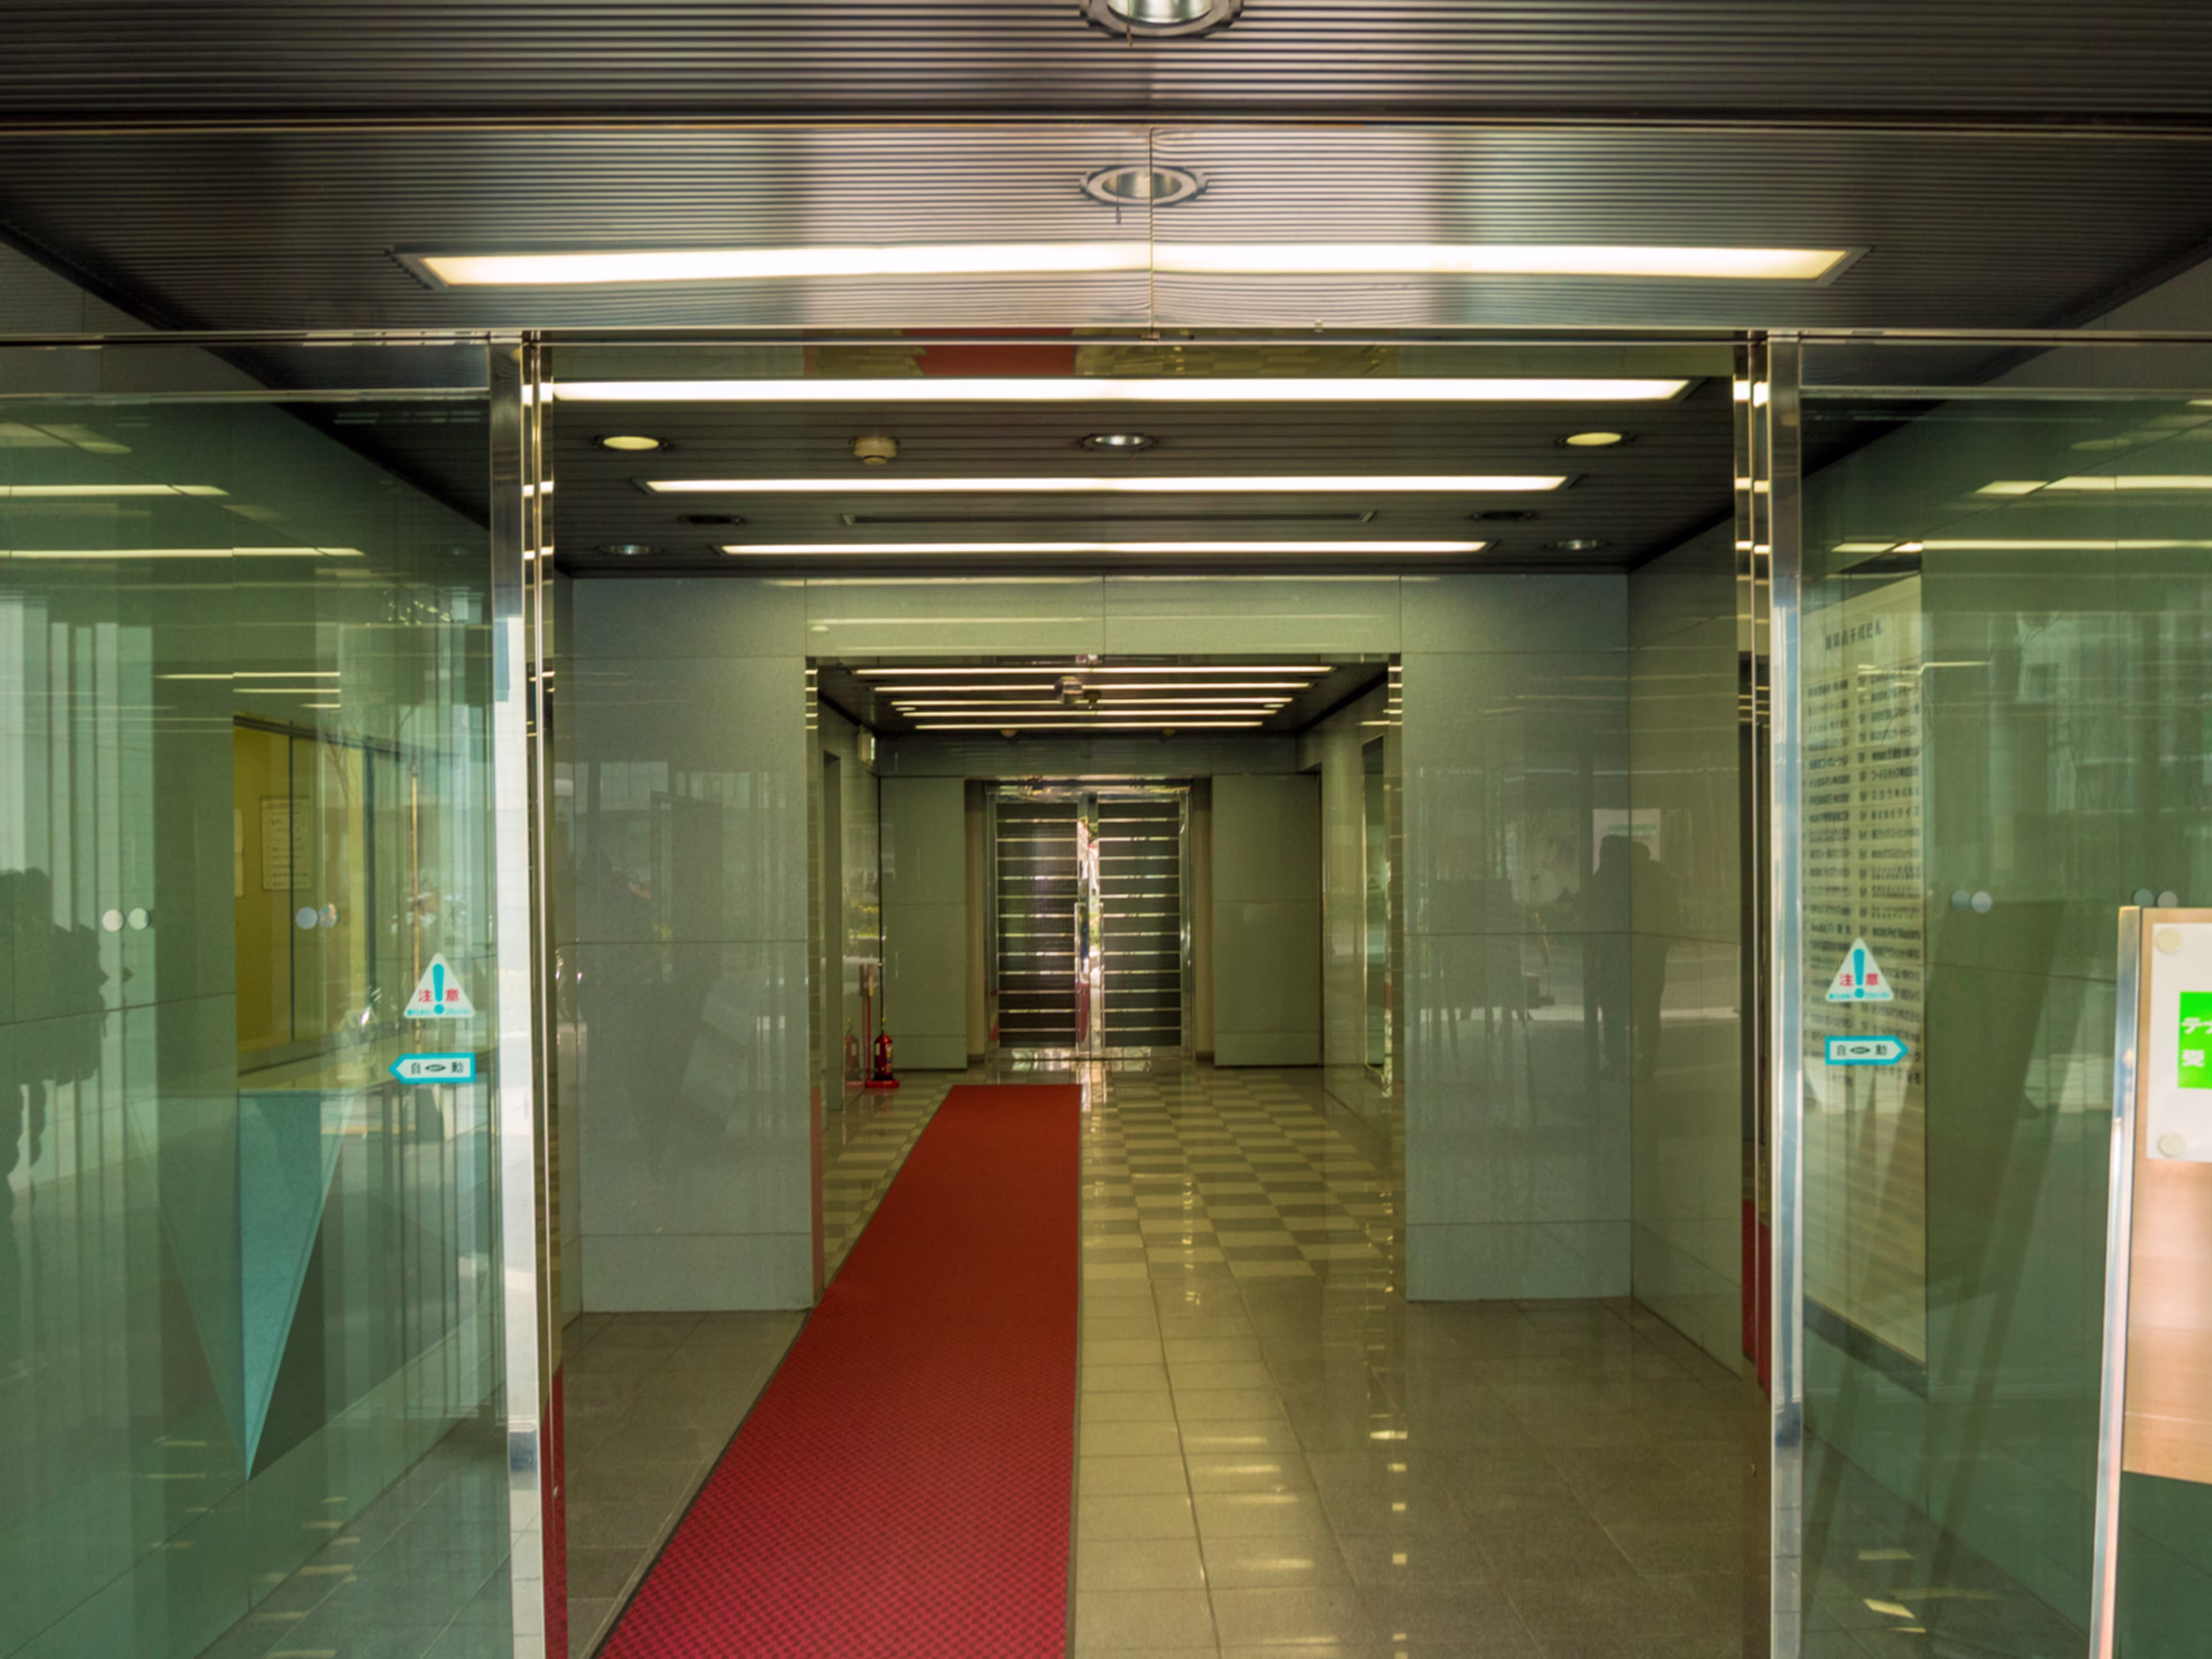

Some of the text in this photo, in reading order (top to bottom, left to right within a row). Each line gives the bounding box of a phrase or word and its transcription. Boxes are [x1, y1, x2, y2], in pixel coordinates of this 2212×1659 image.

[1839, 972, 1879, 987] 注意
[418, 988, 460, 1002] 注意
[1836, 1044, 1887, 1056] 自動
[411, 1062, 464, 1075] 自動
